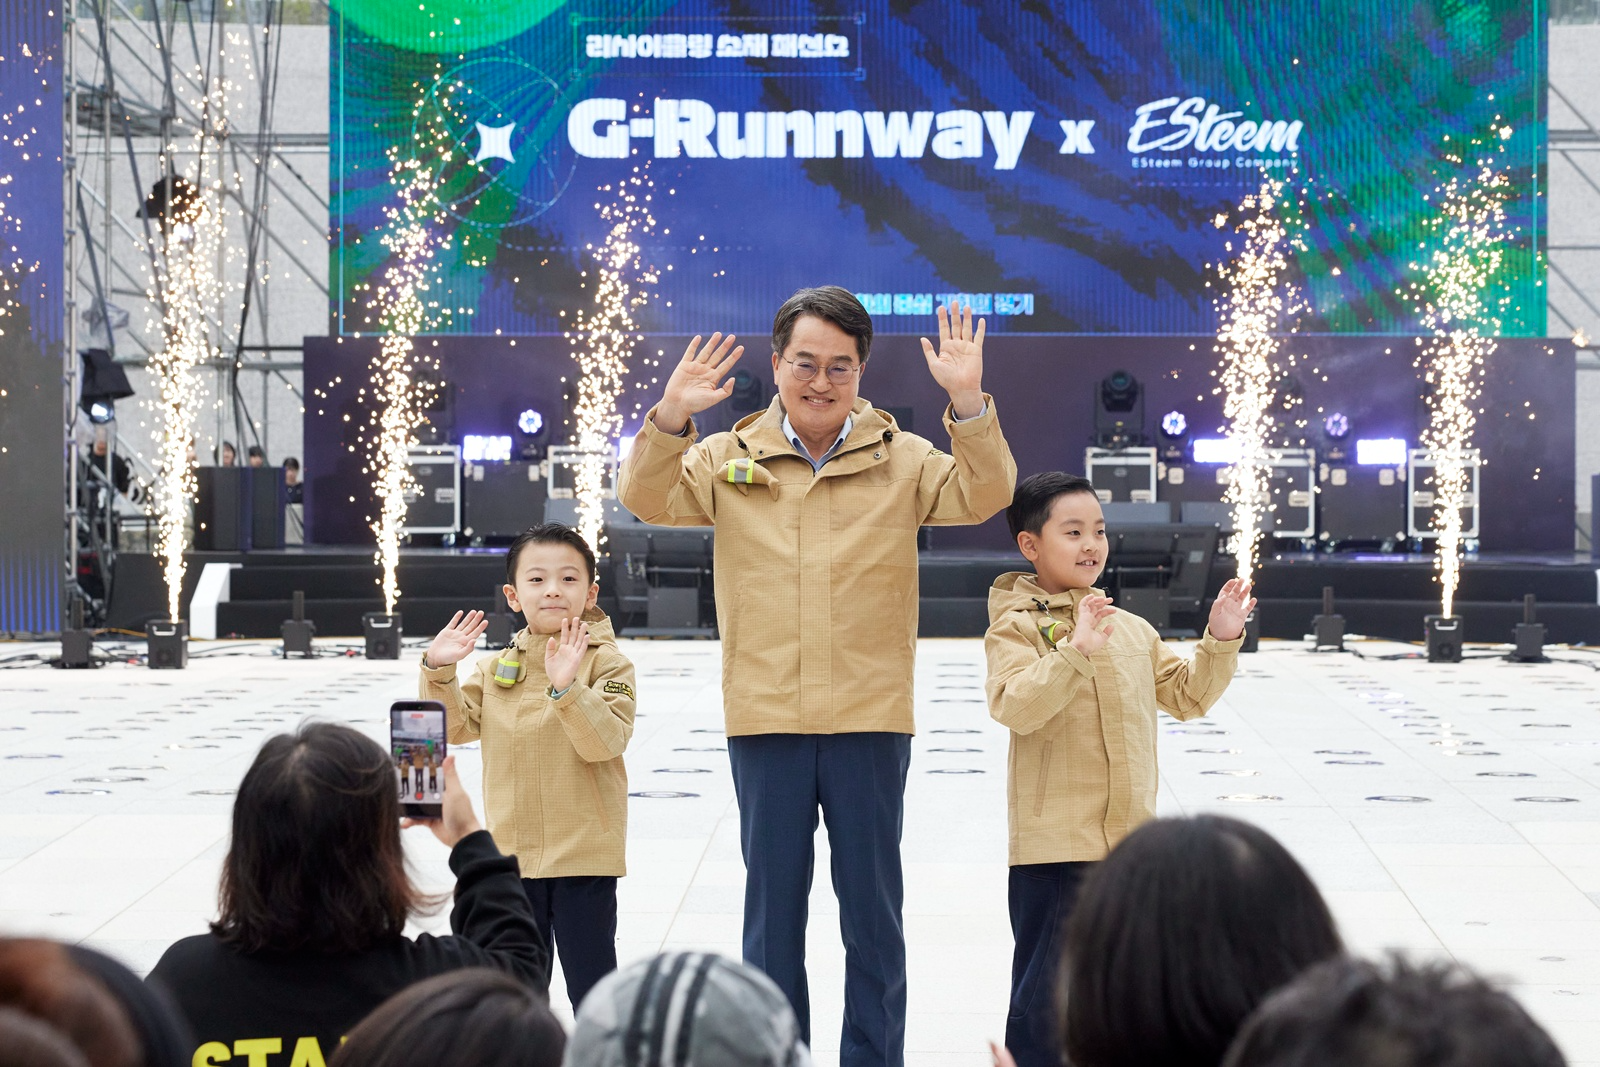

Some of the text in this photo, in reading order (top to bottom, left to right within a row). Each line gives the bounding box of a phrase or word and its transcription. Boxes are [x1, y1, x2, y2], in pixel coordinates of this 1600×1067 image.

[715, 33, 769, 58] 소재
[770, 33, 850, 58] 패션쇼
[567, 97, 1034, 170] G-Runnway
[1126, 96, 1304, 154] ESteem
[1131, 156, 1299, 170] ESteem Group Company
